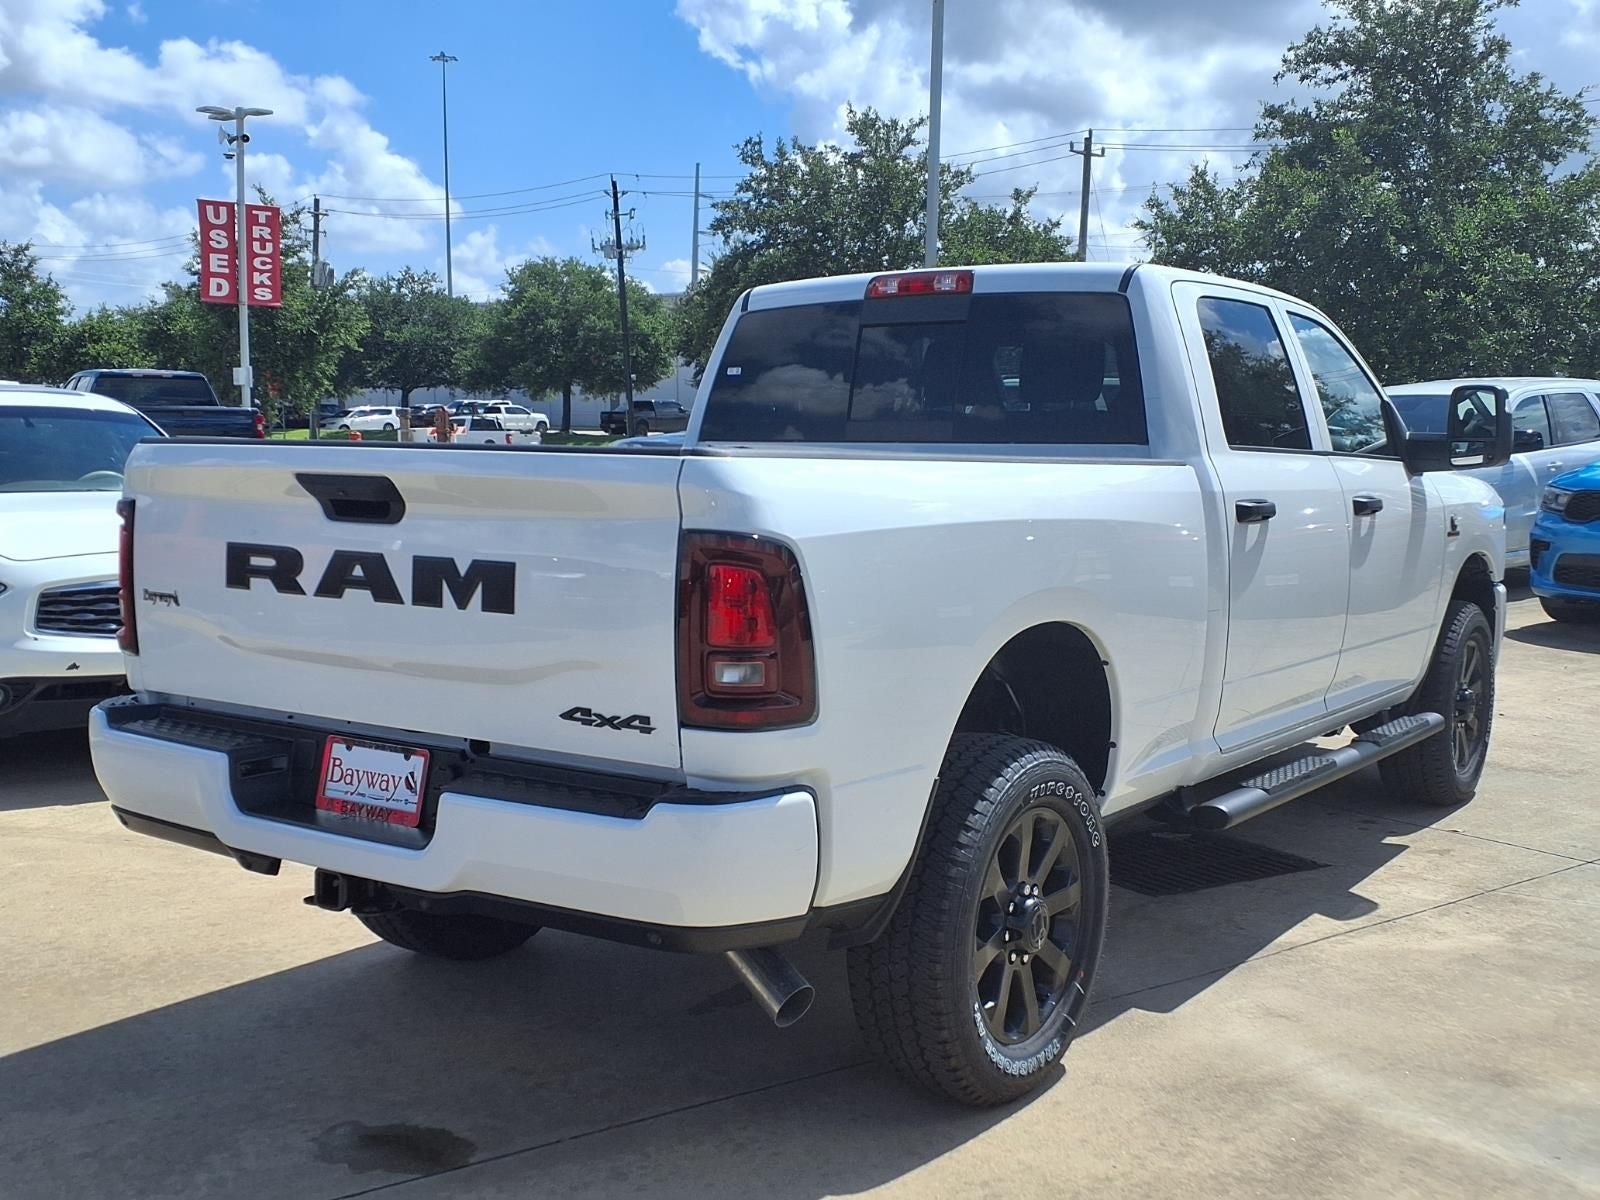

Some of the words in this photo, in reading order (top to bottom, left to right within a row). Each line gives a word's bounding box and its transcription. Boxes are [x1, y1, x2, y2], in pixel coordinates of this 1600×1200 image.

[206, 205, 230, 297] USED
[252, 210, 273, 300] TRUCKS
[226, 541, 516, 614] RAM
[328, 757, 402, 802] Bayway
[341, 801, 392, 820] BAYWAY
